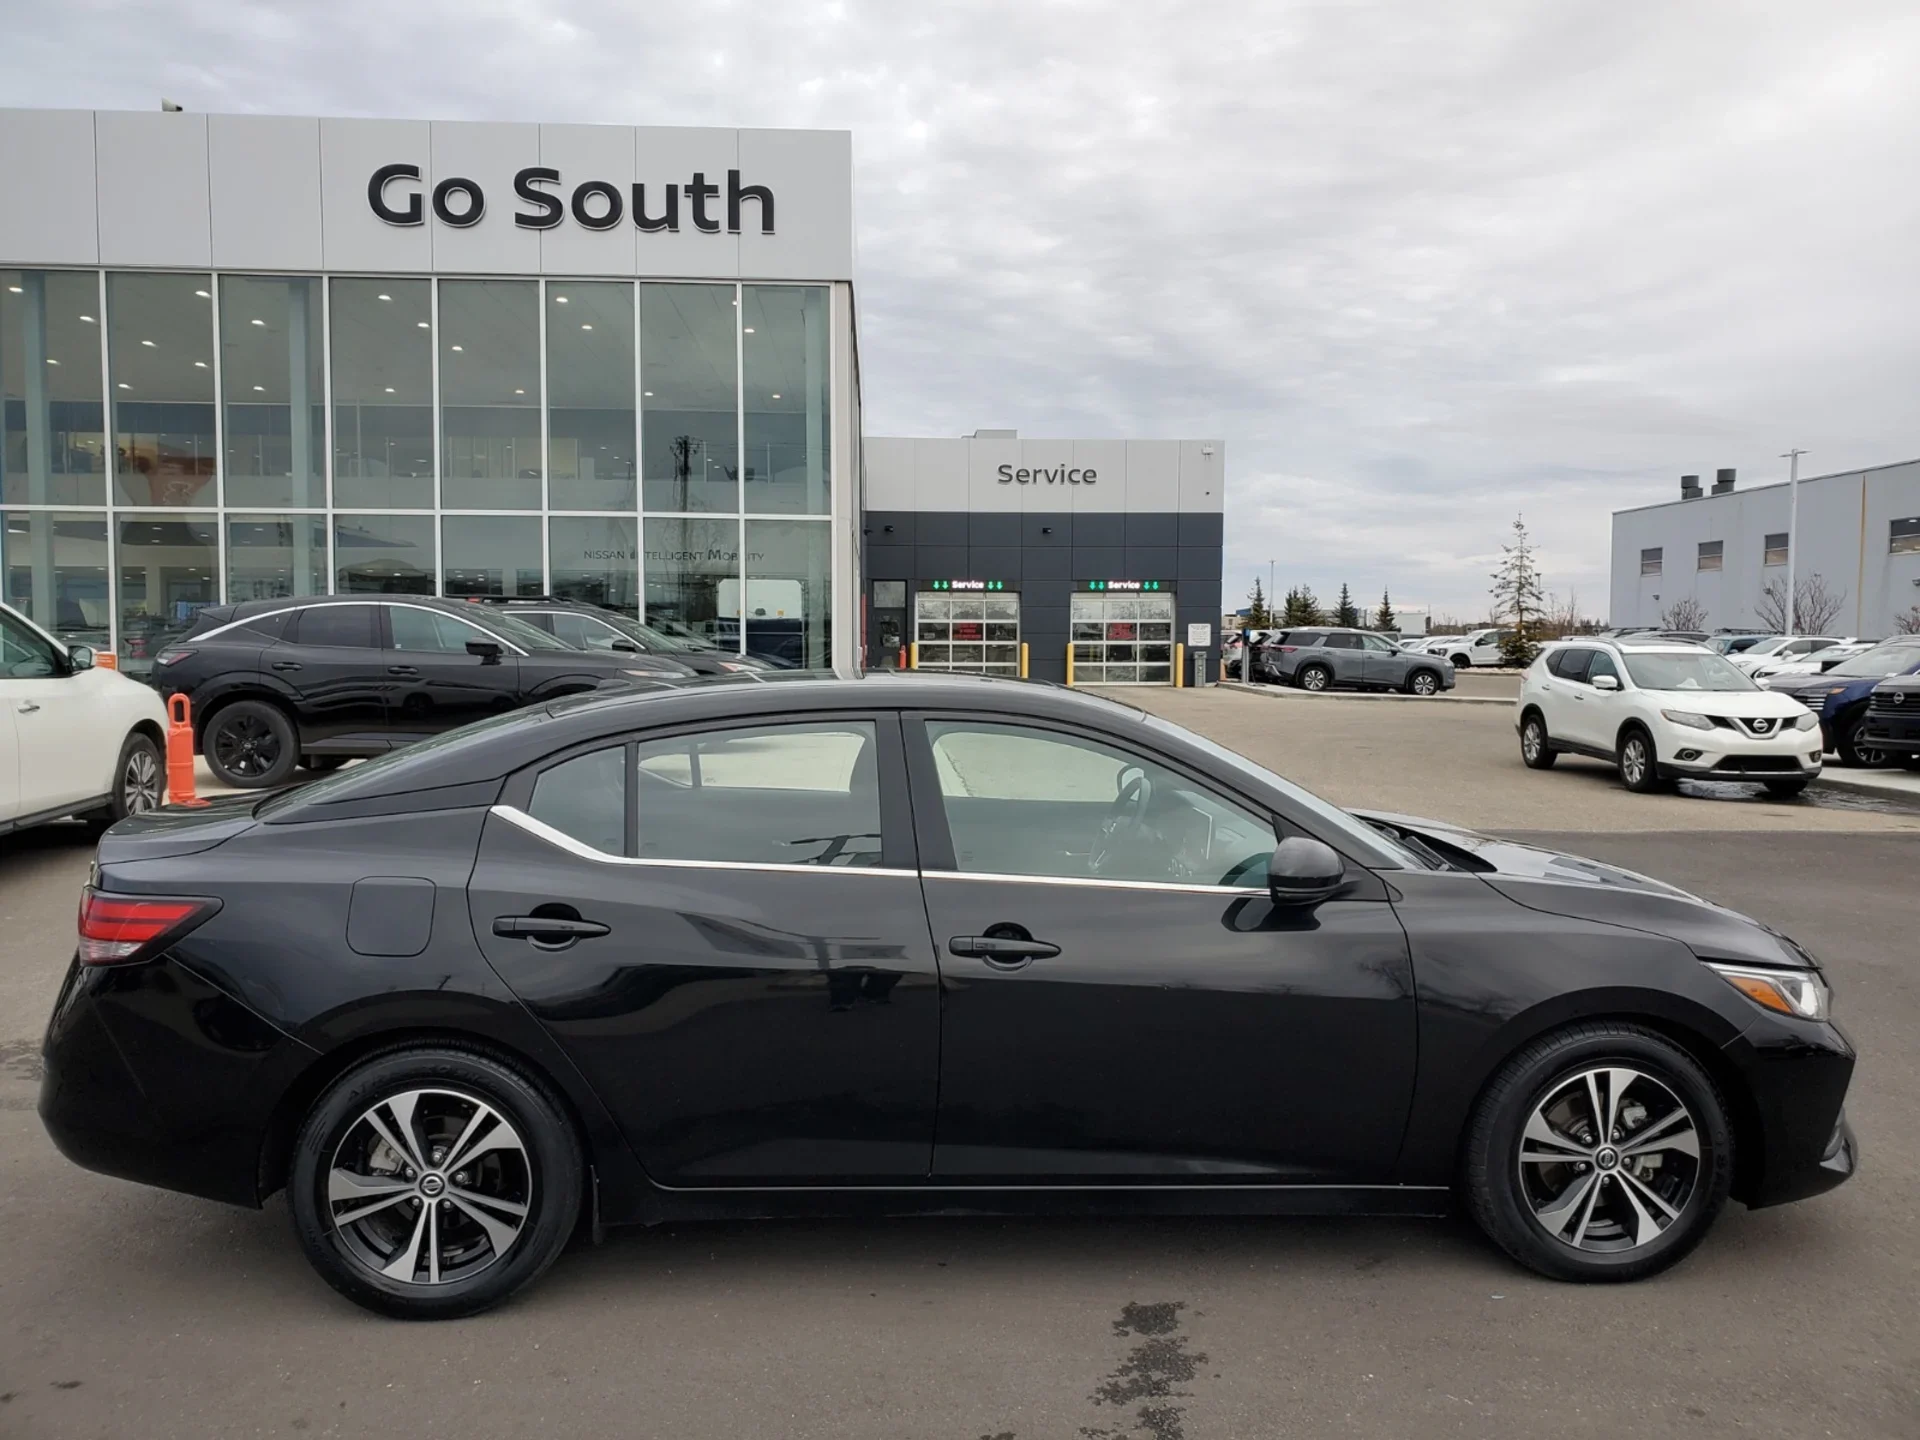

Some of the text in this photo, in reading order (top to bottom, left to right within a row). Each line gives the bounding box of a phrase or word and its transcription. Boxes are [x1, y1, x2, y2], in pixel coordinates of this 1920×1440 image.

[367, 163, 776, 235] Go South
[997, 463, 1098, 485] Service
[583, 549, 765, 561] NISSAN ITELLIGENT MOBITY
[951, 580, 985, 589] Service
[1107, 580, 1141, 589] Service
